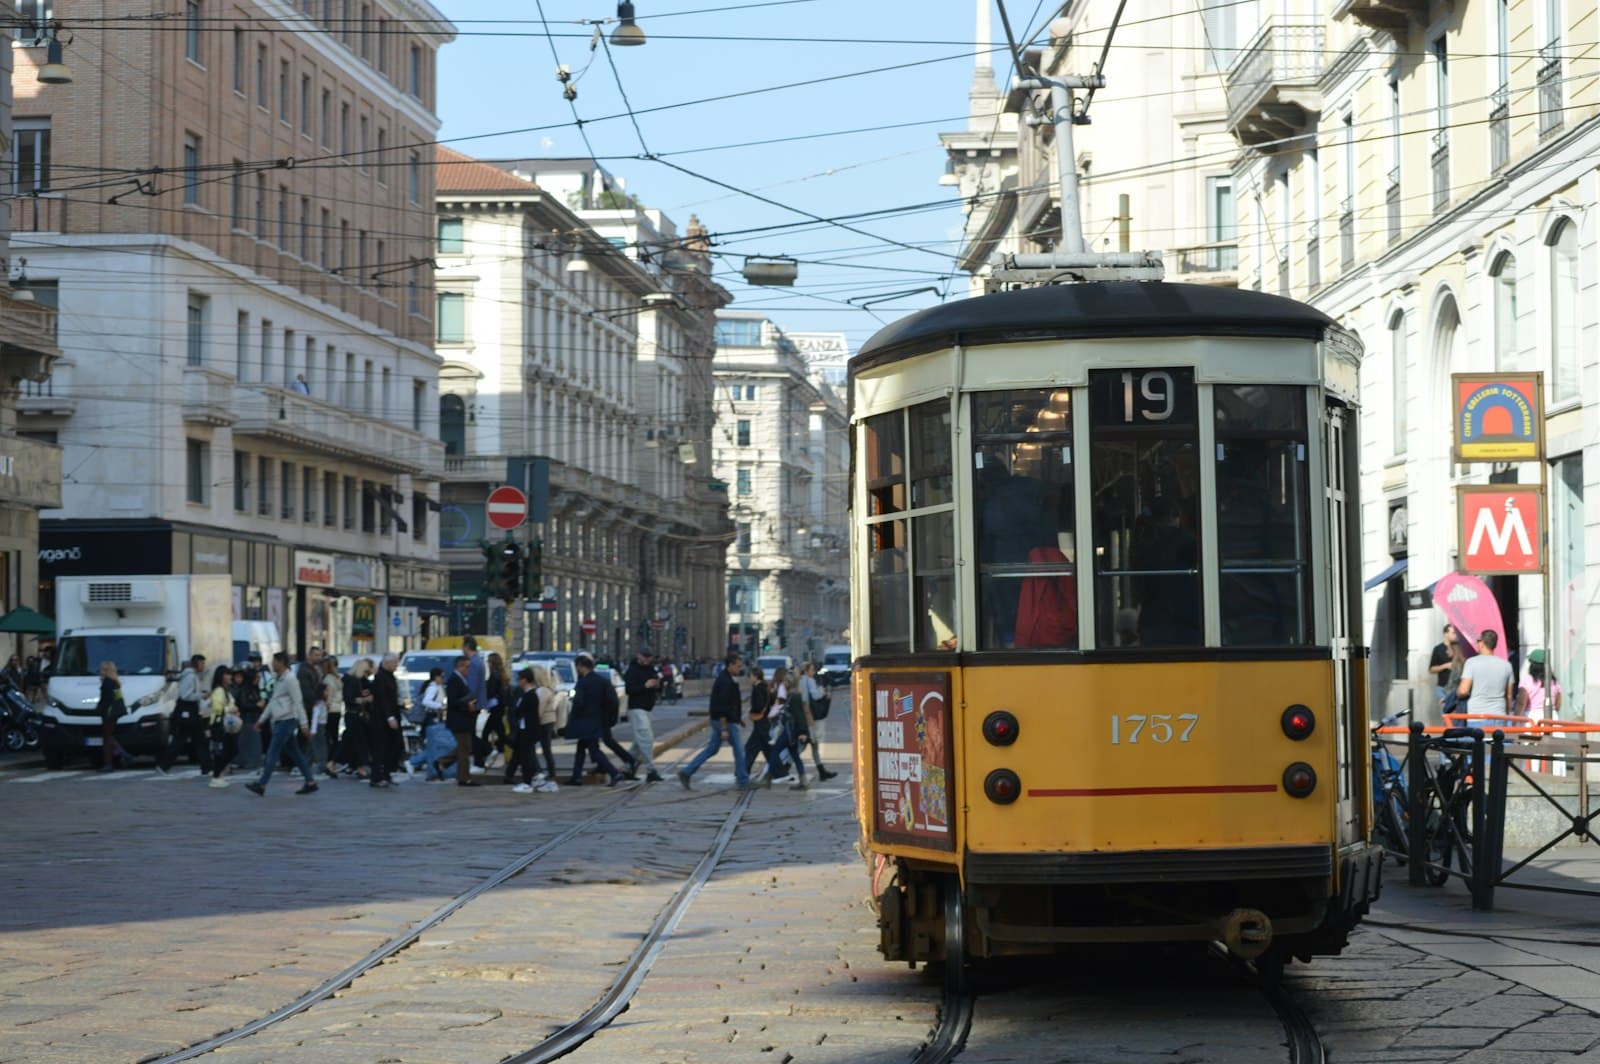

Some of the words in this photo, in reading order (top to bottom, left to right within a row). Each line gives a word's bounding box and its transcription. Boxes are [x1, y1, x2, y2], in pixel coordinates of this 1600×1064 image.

[1120, 370, 1174, 423] 19
[1466, 507, 1533, 556] M
[1110, 712, 1199, 744] 1757
